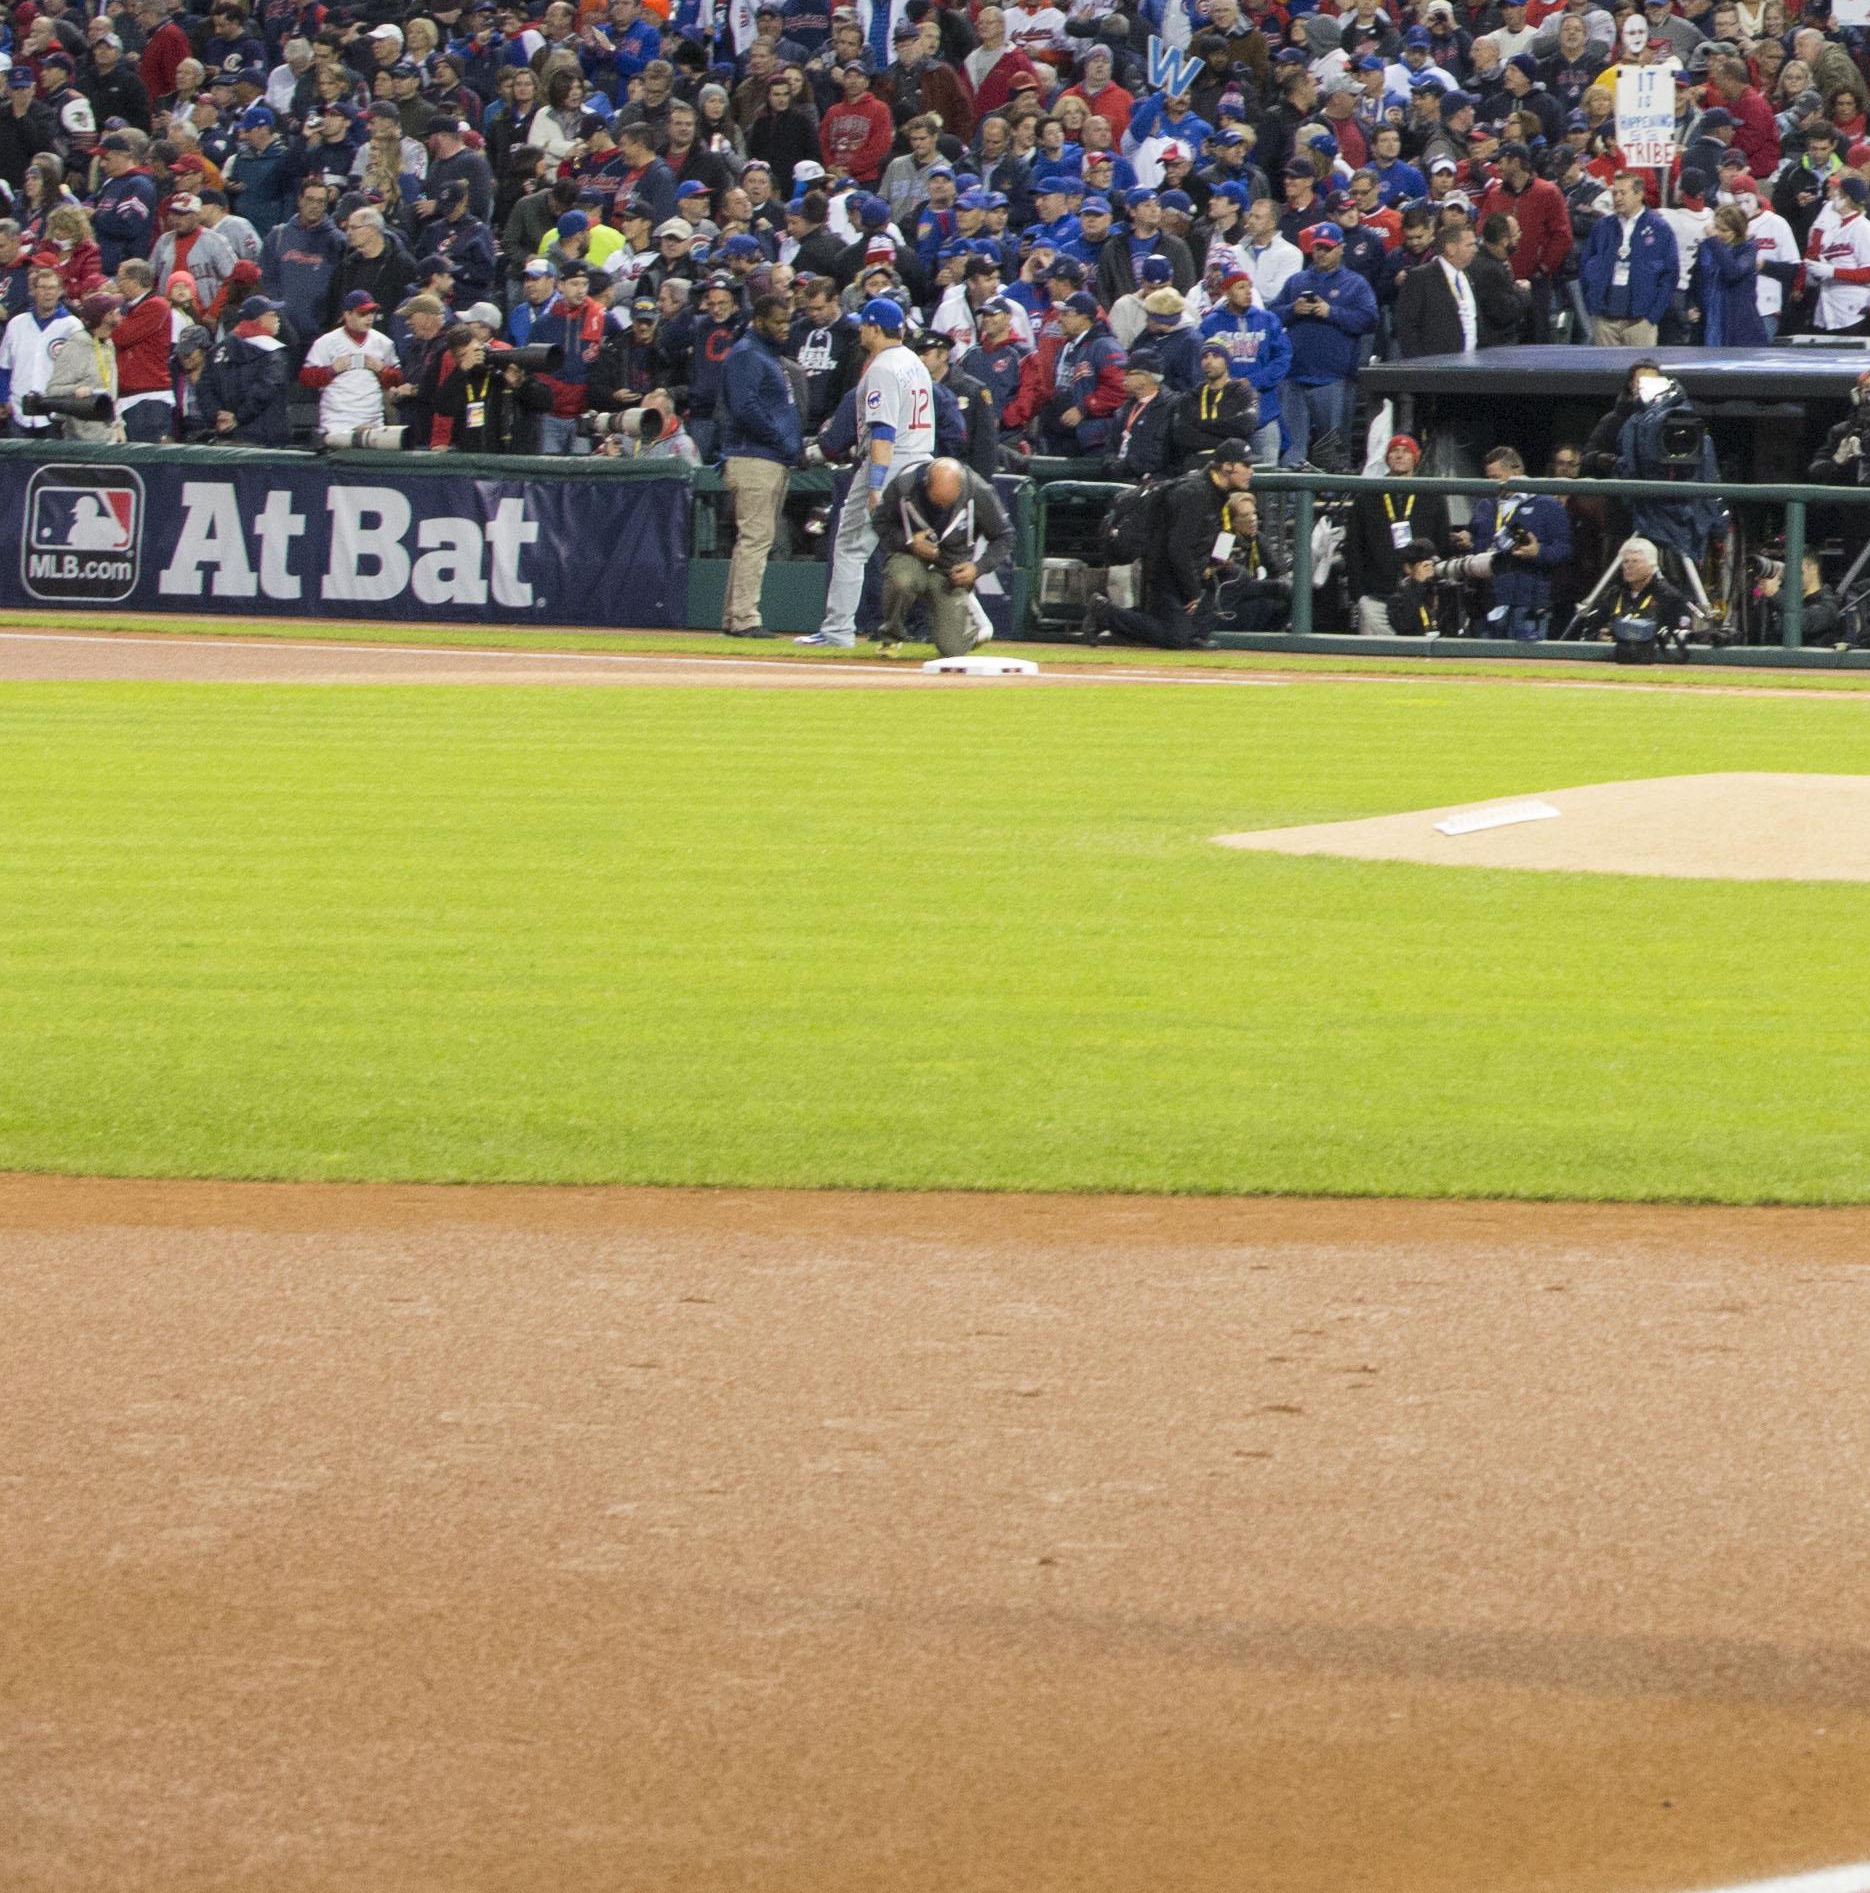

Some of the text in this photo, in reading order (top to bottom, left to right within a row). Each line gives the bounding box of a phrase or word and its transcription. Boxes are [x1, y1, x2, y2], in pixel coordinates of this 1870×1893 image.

[1148, 34, 1206, 99] W
[1637, 72, 1657, 93] IT
[1623, 142, 1673, 164] TRIBE
[908, 389, 931, 429] 12
[159, 481, 539, 608] At Bat
[29, 554, 132, 581] MLB.com
